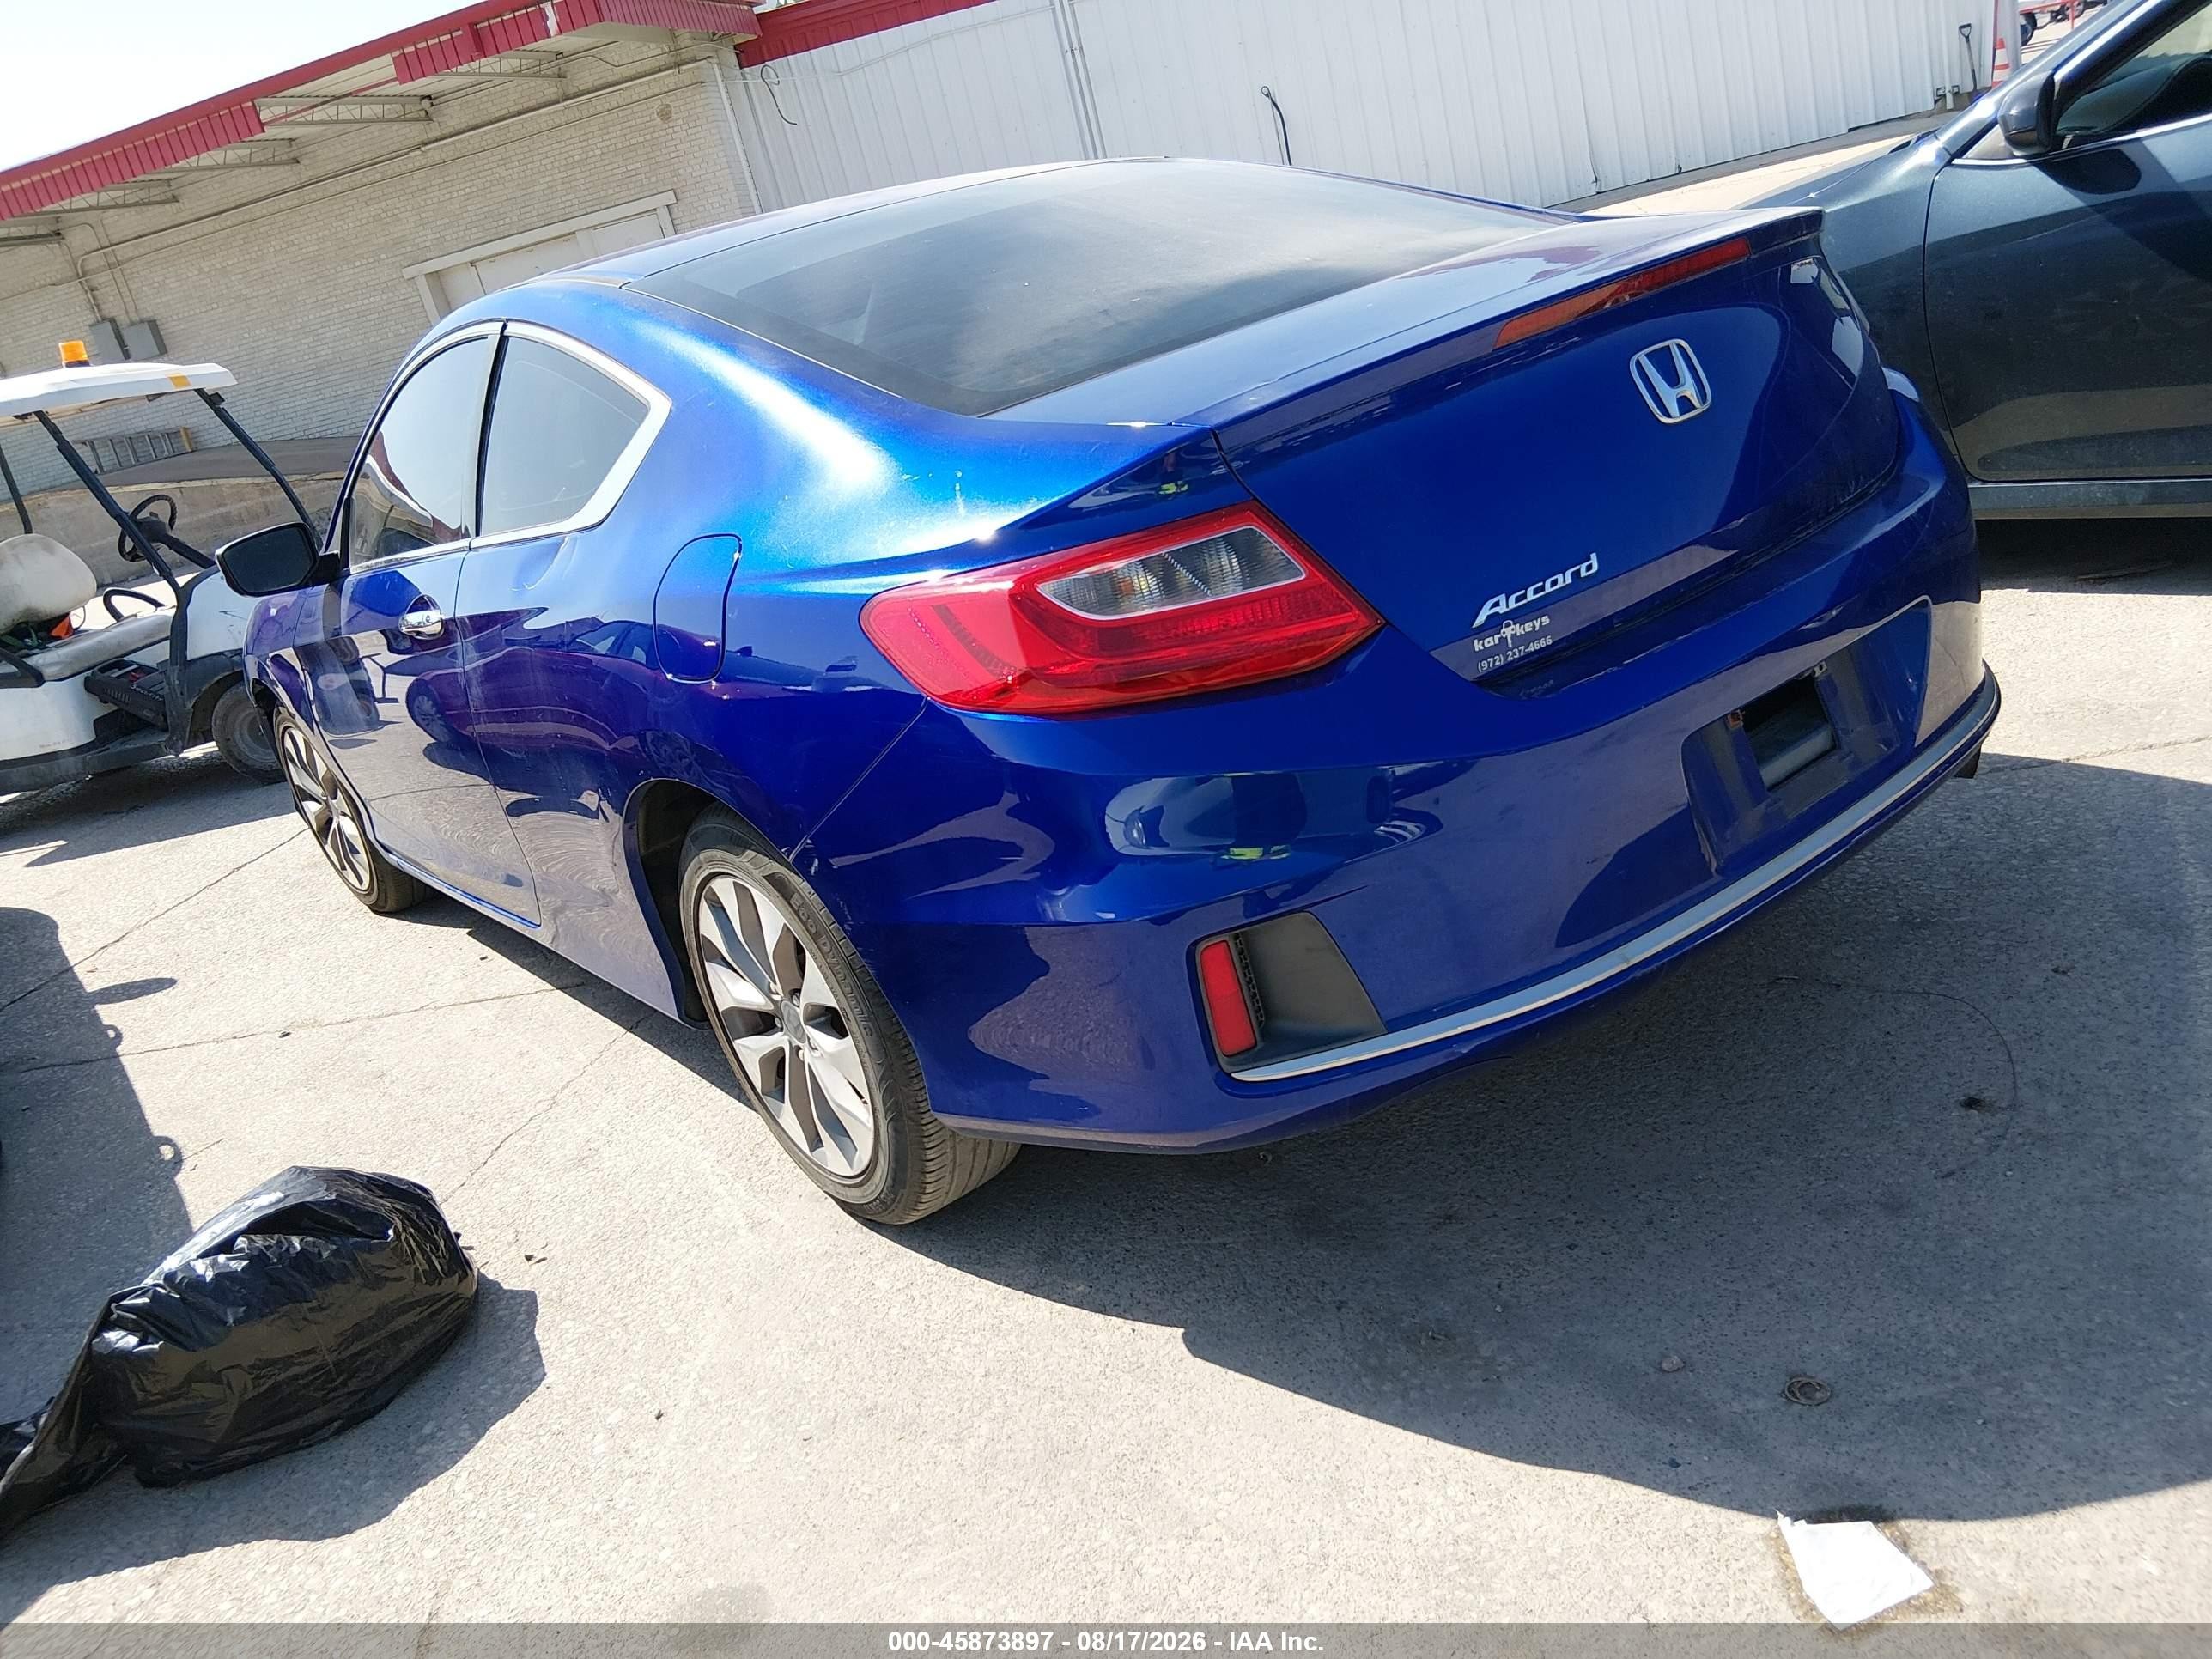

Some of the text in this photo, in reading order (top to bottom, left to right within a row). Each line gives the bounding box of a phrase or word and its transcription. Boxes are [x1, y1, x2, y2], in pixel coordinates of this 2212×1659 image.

[1472, 552, 1598, 628] Accord
[1479, 635, 1553, 672] (972) 237-4666
[1516, 615, 1550, 636] keys
[790, 892, 817, 934] Eco
[818, 934, 872, 1038] Dynamic
